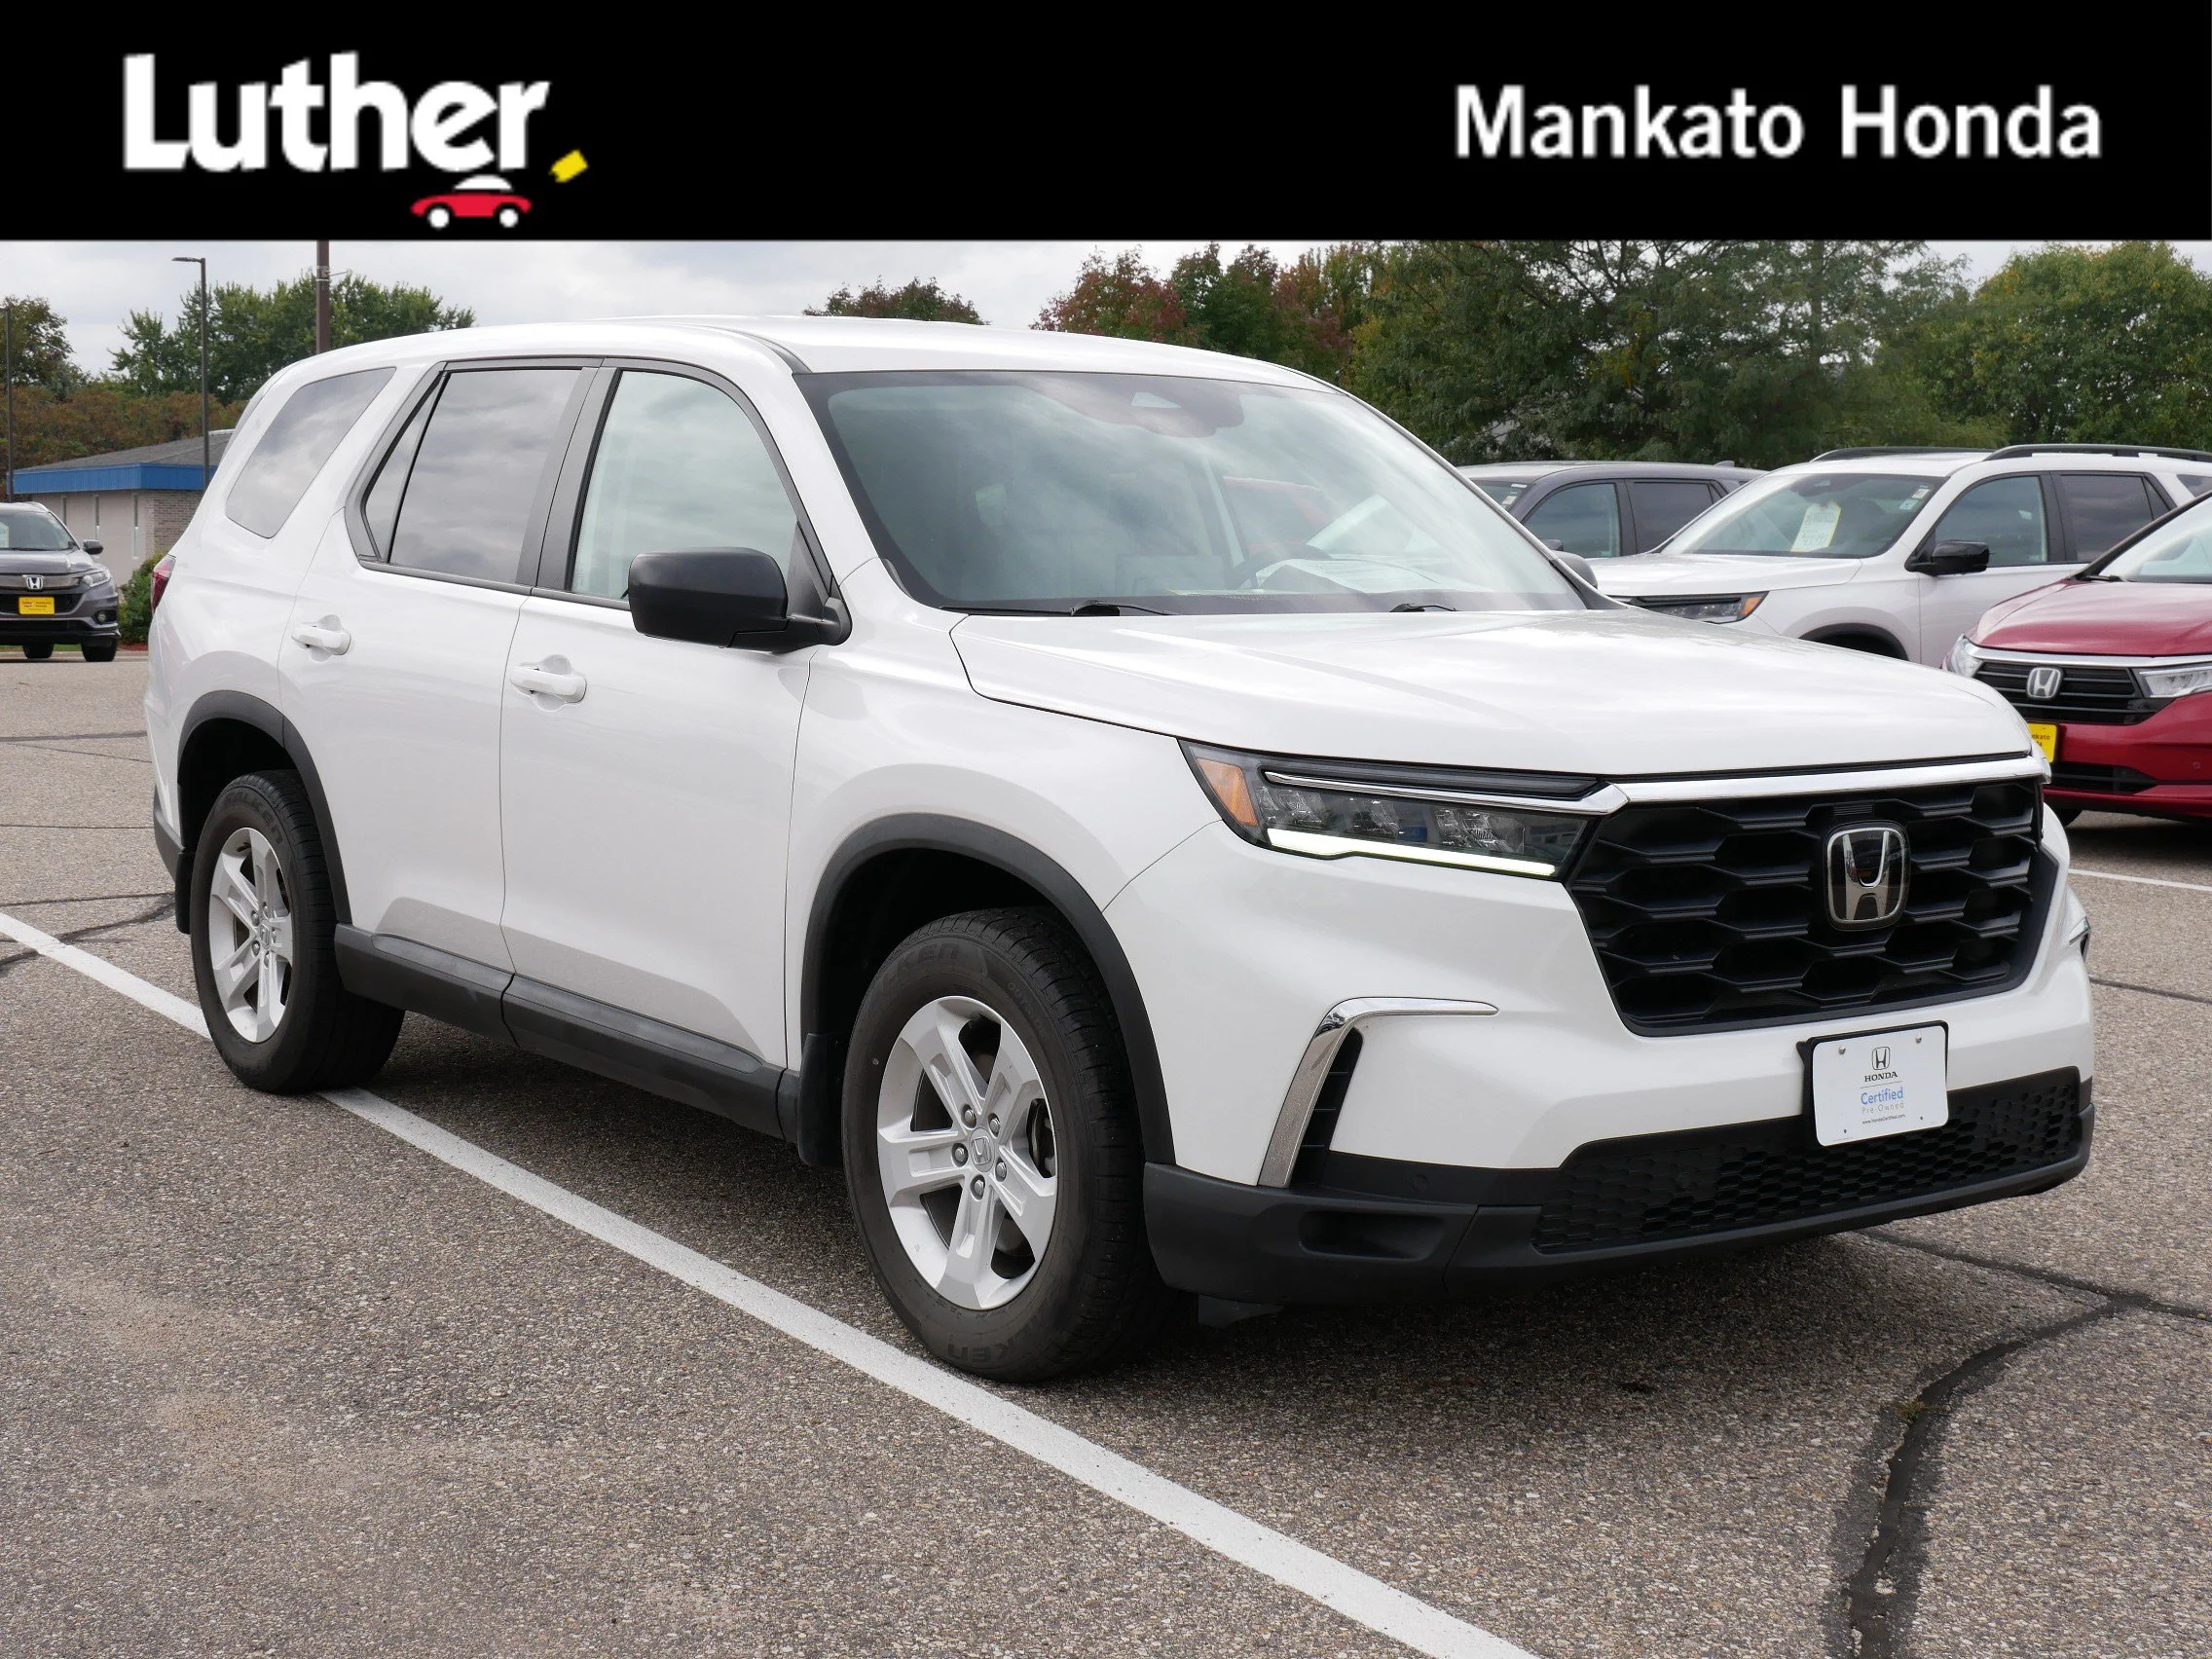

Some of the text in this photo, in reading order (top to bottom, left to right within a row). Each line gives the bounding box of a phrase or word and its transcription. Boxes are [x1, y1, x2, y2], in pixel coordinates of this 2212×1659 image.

[1864, 1071, 1898, 1082] HONDA
[1862, 1087, 1902, 1104] Certified
[1862, 1100, 1904, 1114] Pre-Owned
